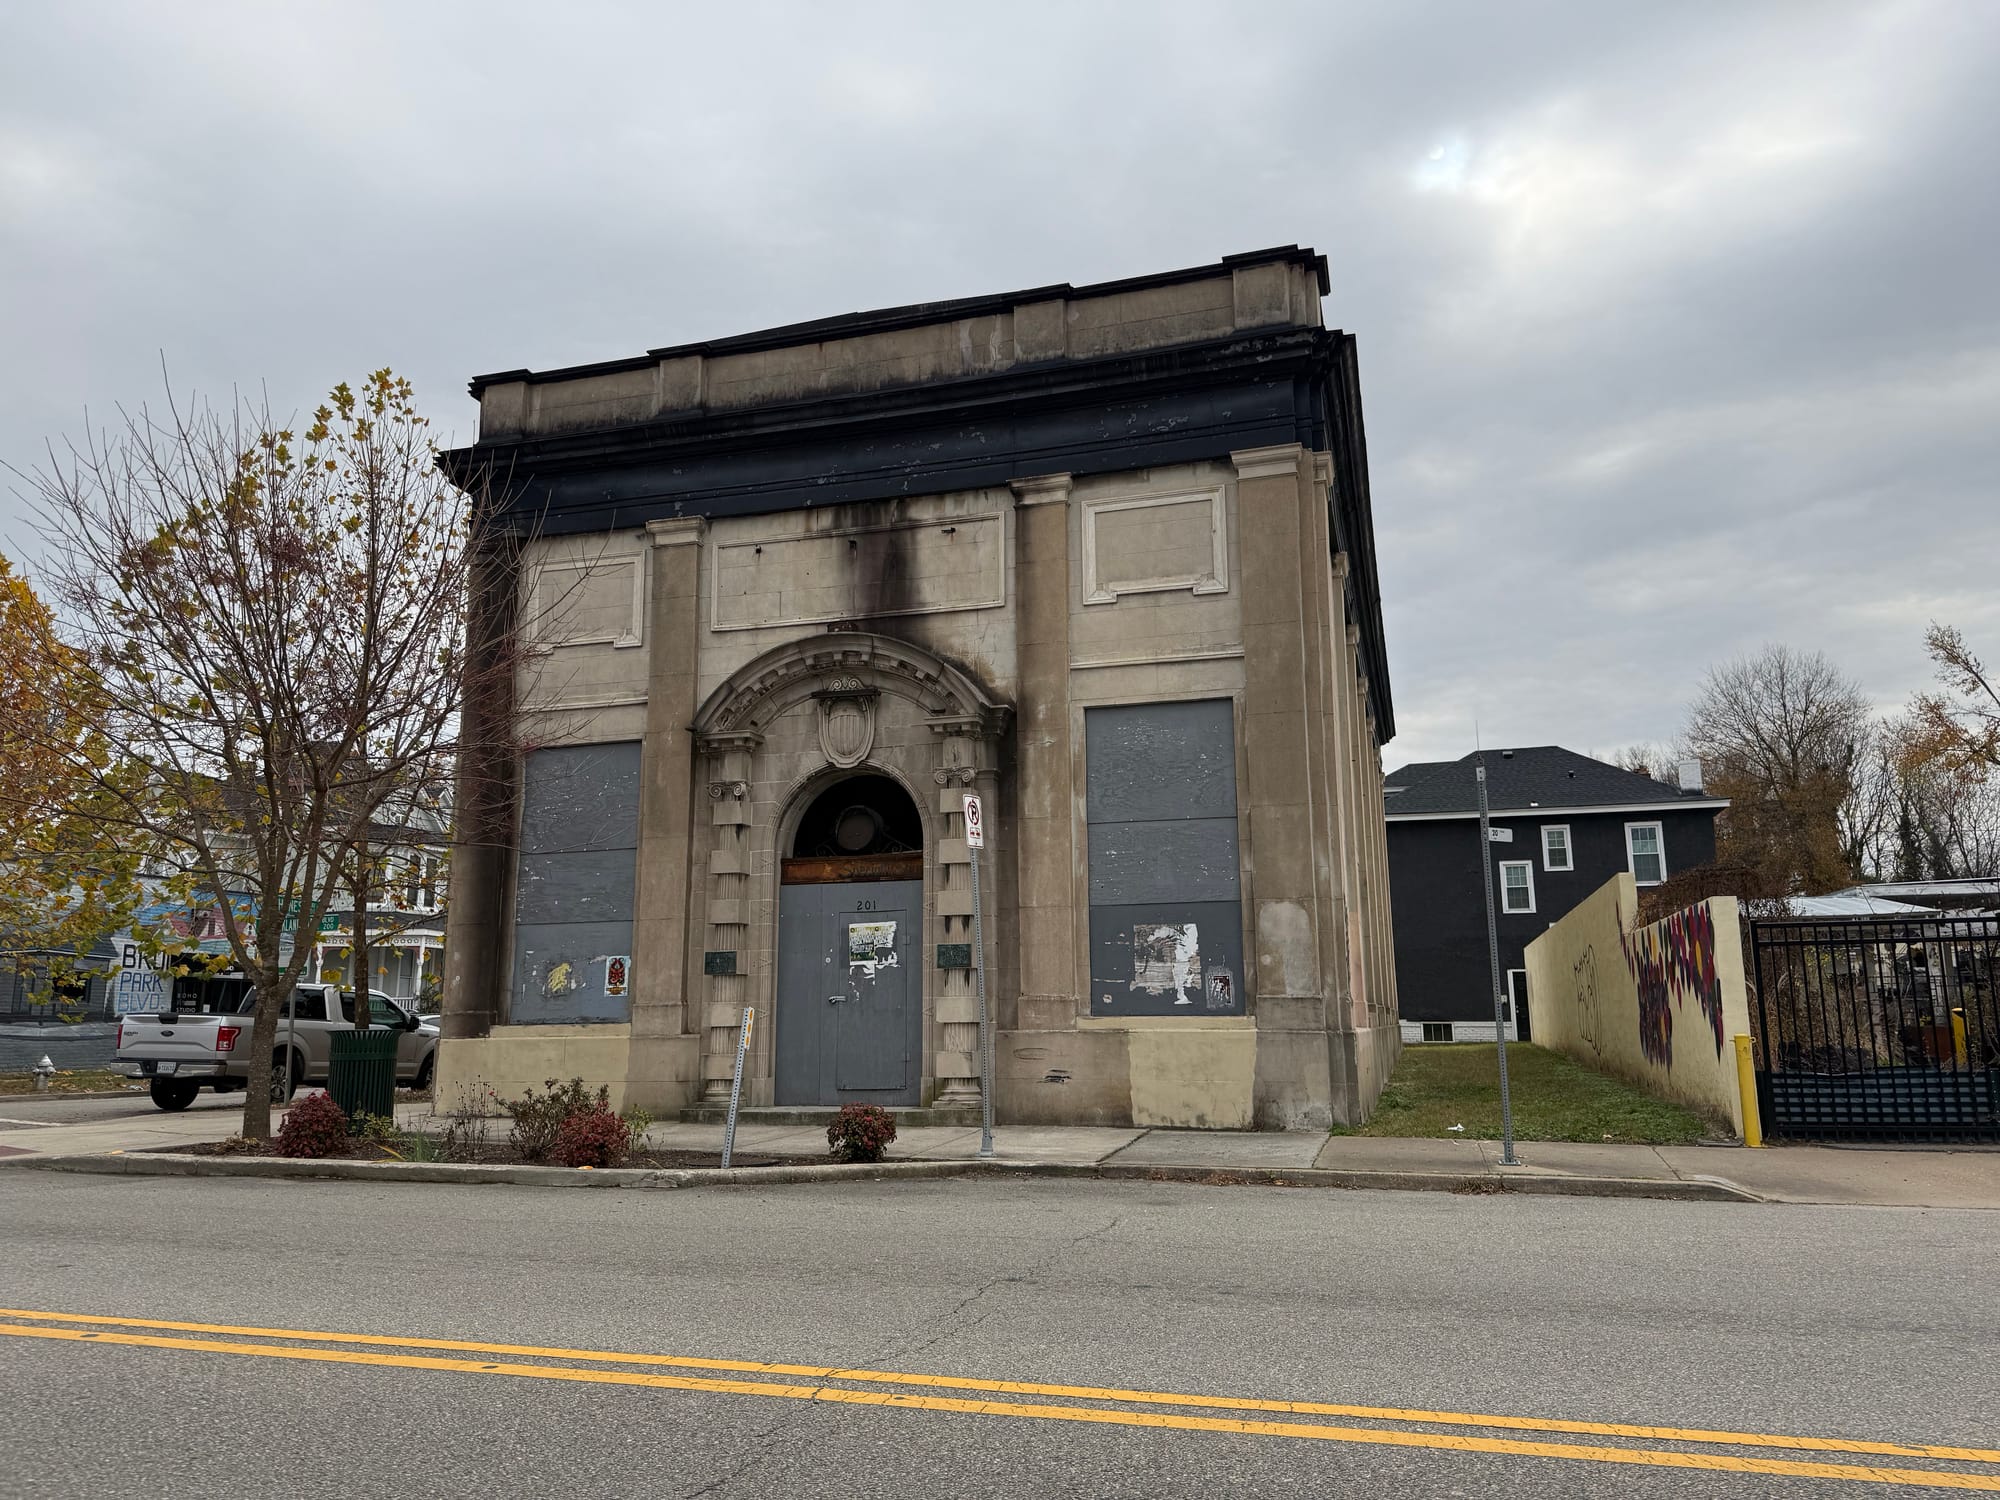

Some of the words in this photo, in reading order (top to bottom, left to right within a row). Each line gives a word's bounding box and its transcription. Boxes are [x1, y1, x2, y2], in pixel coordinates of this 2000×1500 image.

[857, 900, 877, 911] 201
[119, 971, 164, 993] PARK
[117, 992, 165, 1012] BLVD.
